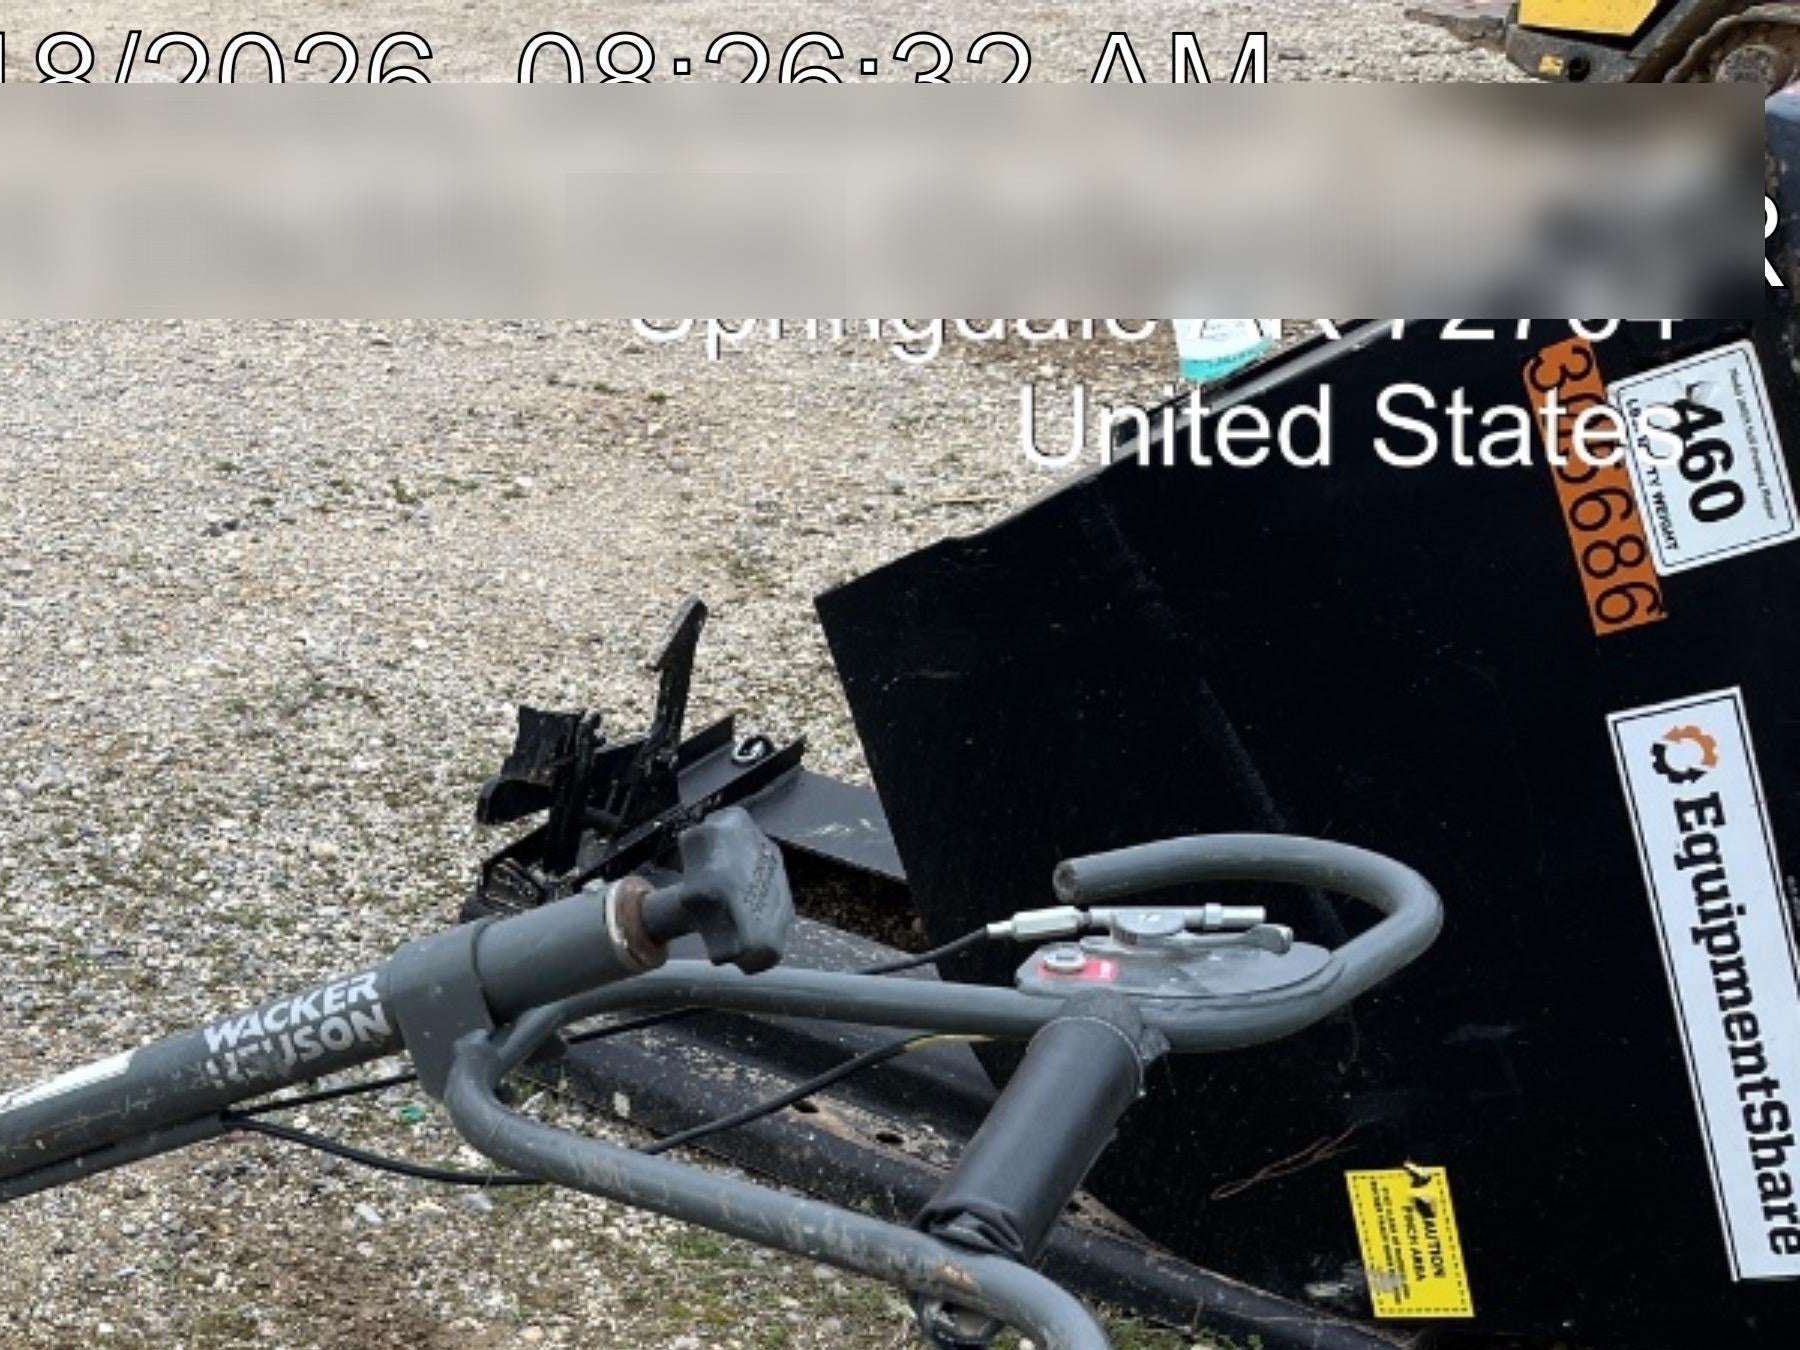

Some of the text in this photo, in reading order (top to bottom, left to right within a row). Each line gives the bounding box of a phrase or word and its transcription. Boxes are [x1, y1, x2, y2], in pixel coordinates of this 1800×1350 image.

[1672, 398, 1745, 523] 460
[203, 970, 379, 1054] WACKER
[1673, 791, 1800, 1256] EquipmentShare
